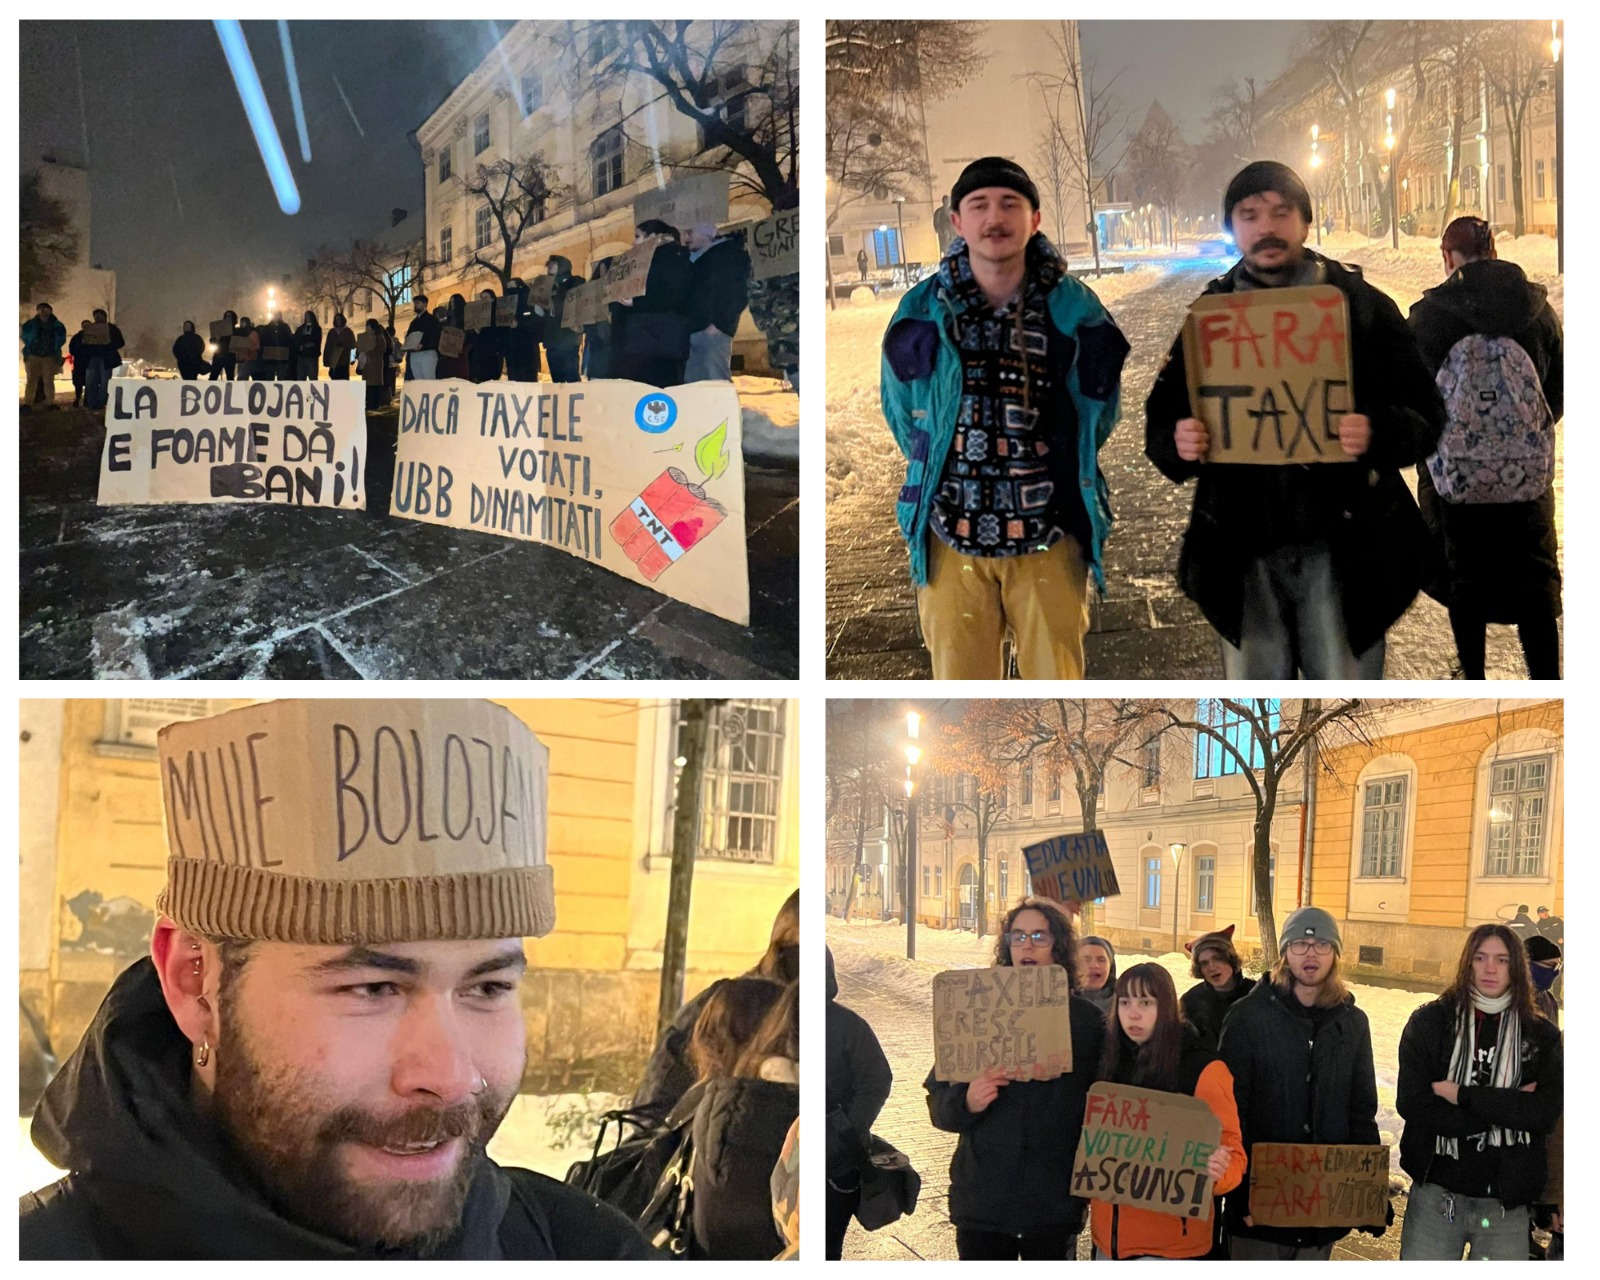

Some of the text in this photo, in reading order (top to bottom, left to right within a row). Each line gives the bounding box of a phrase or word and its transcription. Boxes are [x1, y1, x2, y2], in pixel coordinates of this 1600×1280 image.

[1200, 294, 1345, 370] FĂRĂ
[114, 382, 329, 421] LA BOLOJAN
[401, 387, 584, 442] DACĂ TAXELE
[1199, 378, 1347, 457] TAXE
[108, 421, 335, 472] E FOAME DĂ
[498, 445, 603, 499] VOTAȚI,
[395, 461, 602, 560] UBB DINAMITAȚI
[638, 506, 673, 545] TNT
[333, 723, 545, 867] BOLOJAN
[935, 967, 1067, 1010] TAXELE
[936, 1008, 1026, 1041] CRESC
[938, 1033, 1038, 1074] BURSELE
[1085, 1093, 1152, 1131] FĂRĂ
[1181, 1139, 1214, 1168] PE
[1074, 1156, 1209, 1217] ASCUNS!
